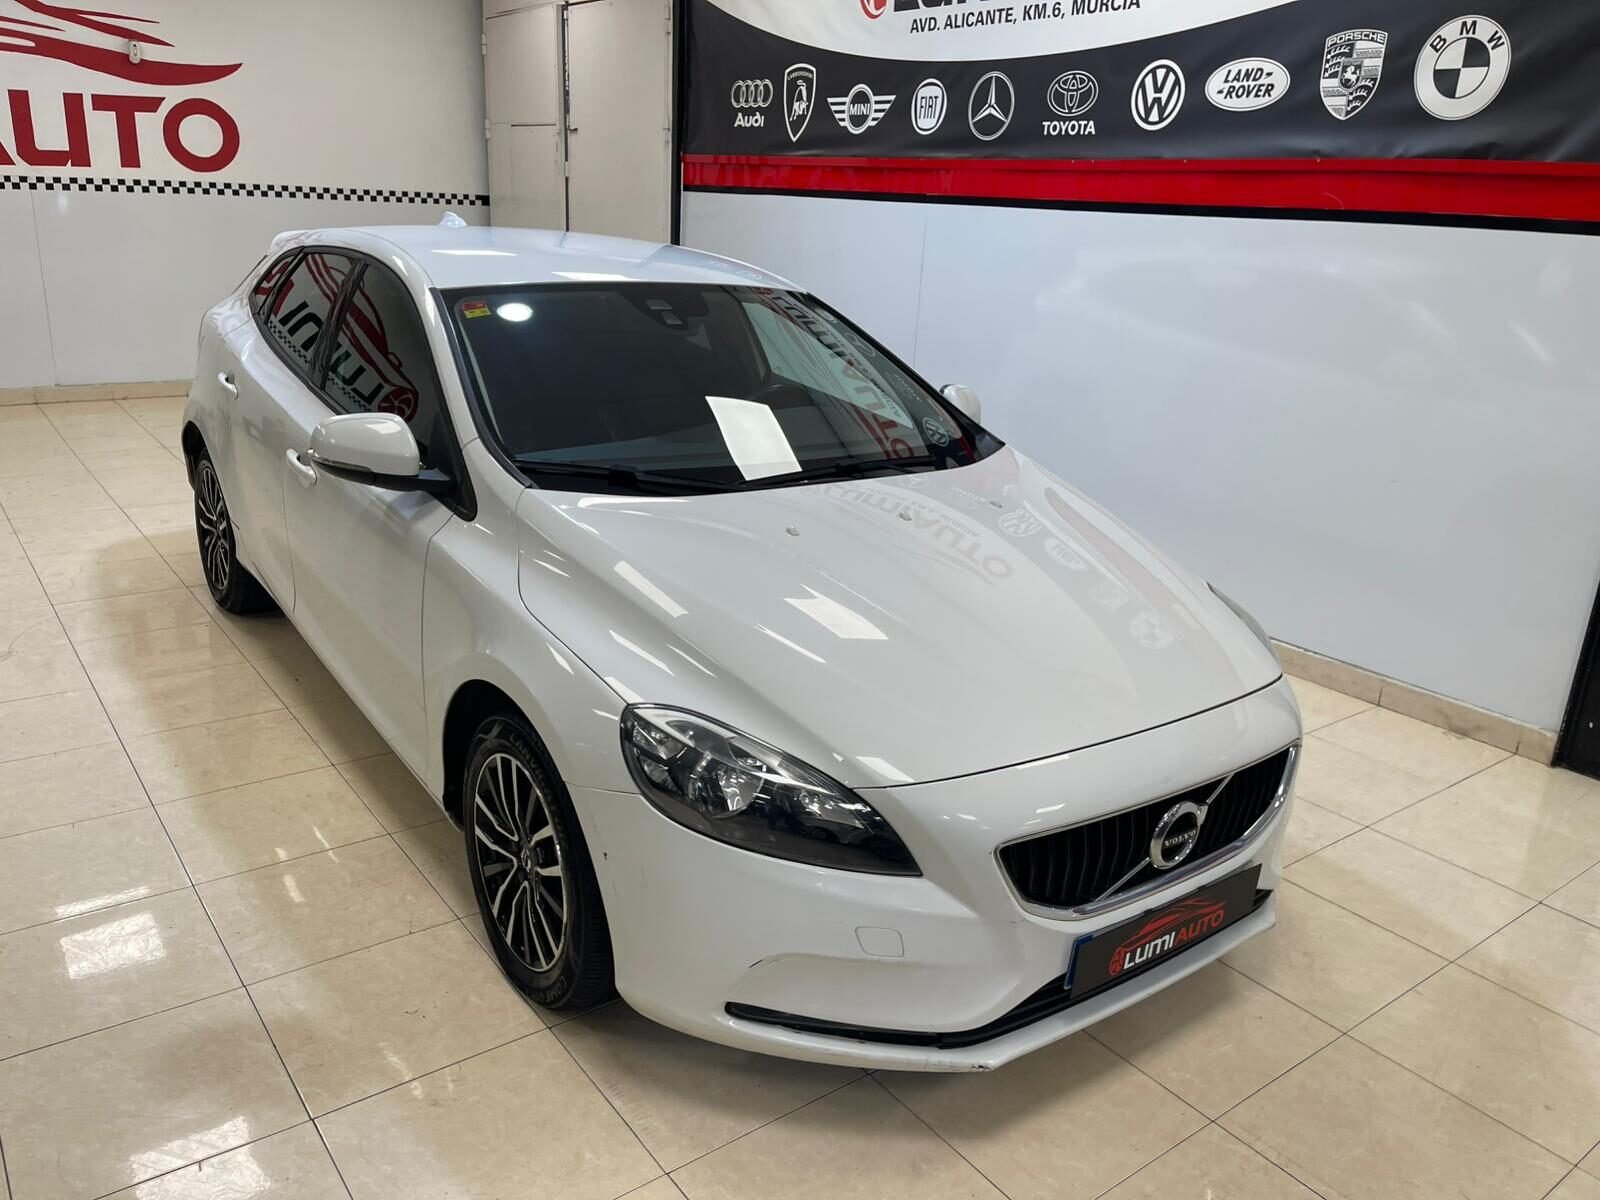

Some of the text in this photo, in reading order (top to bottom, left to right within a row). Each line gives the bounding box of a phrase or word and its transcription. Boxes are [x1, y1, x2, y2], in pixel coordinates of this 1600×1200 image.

[910, 16, 940, 33] AVD.
[943, 7, 1017, 30] ALICANTE,
[1022, 1, 1065, 22] KM.6,
[1327, 31, 1386, 47] PORSCHE
[1429, 20, 1505, 53] BMW
[1223, 67, 1264, 84] LAND
[1224, 83, 1275, 99] ROVER
[849, 103, 871, 115] MINI
[918, 95, 939, 119] FIAT
[734, 111, 765, 127] Audi
[0, 89, 240, 172] UTO
[1042, 120, 1096, 136] TOYOTA
[1164, 830, 1196, 847] VOLVO
